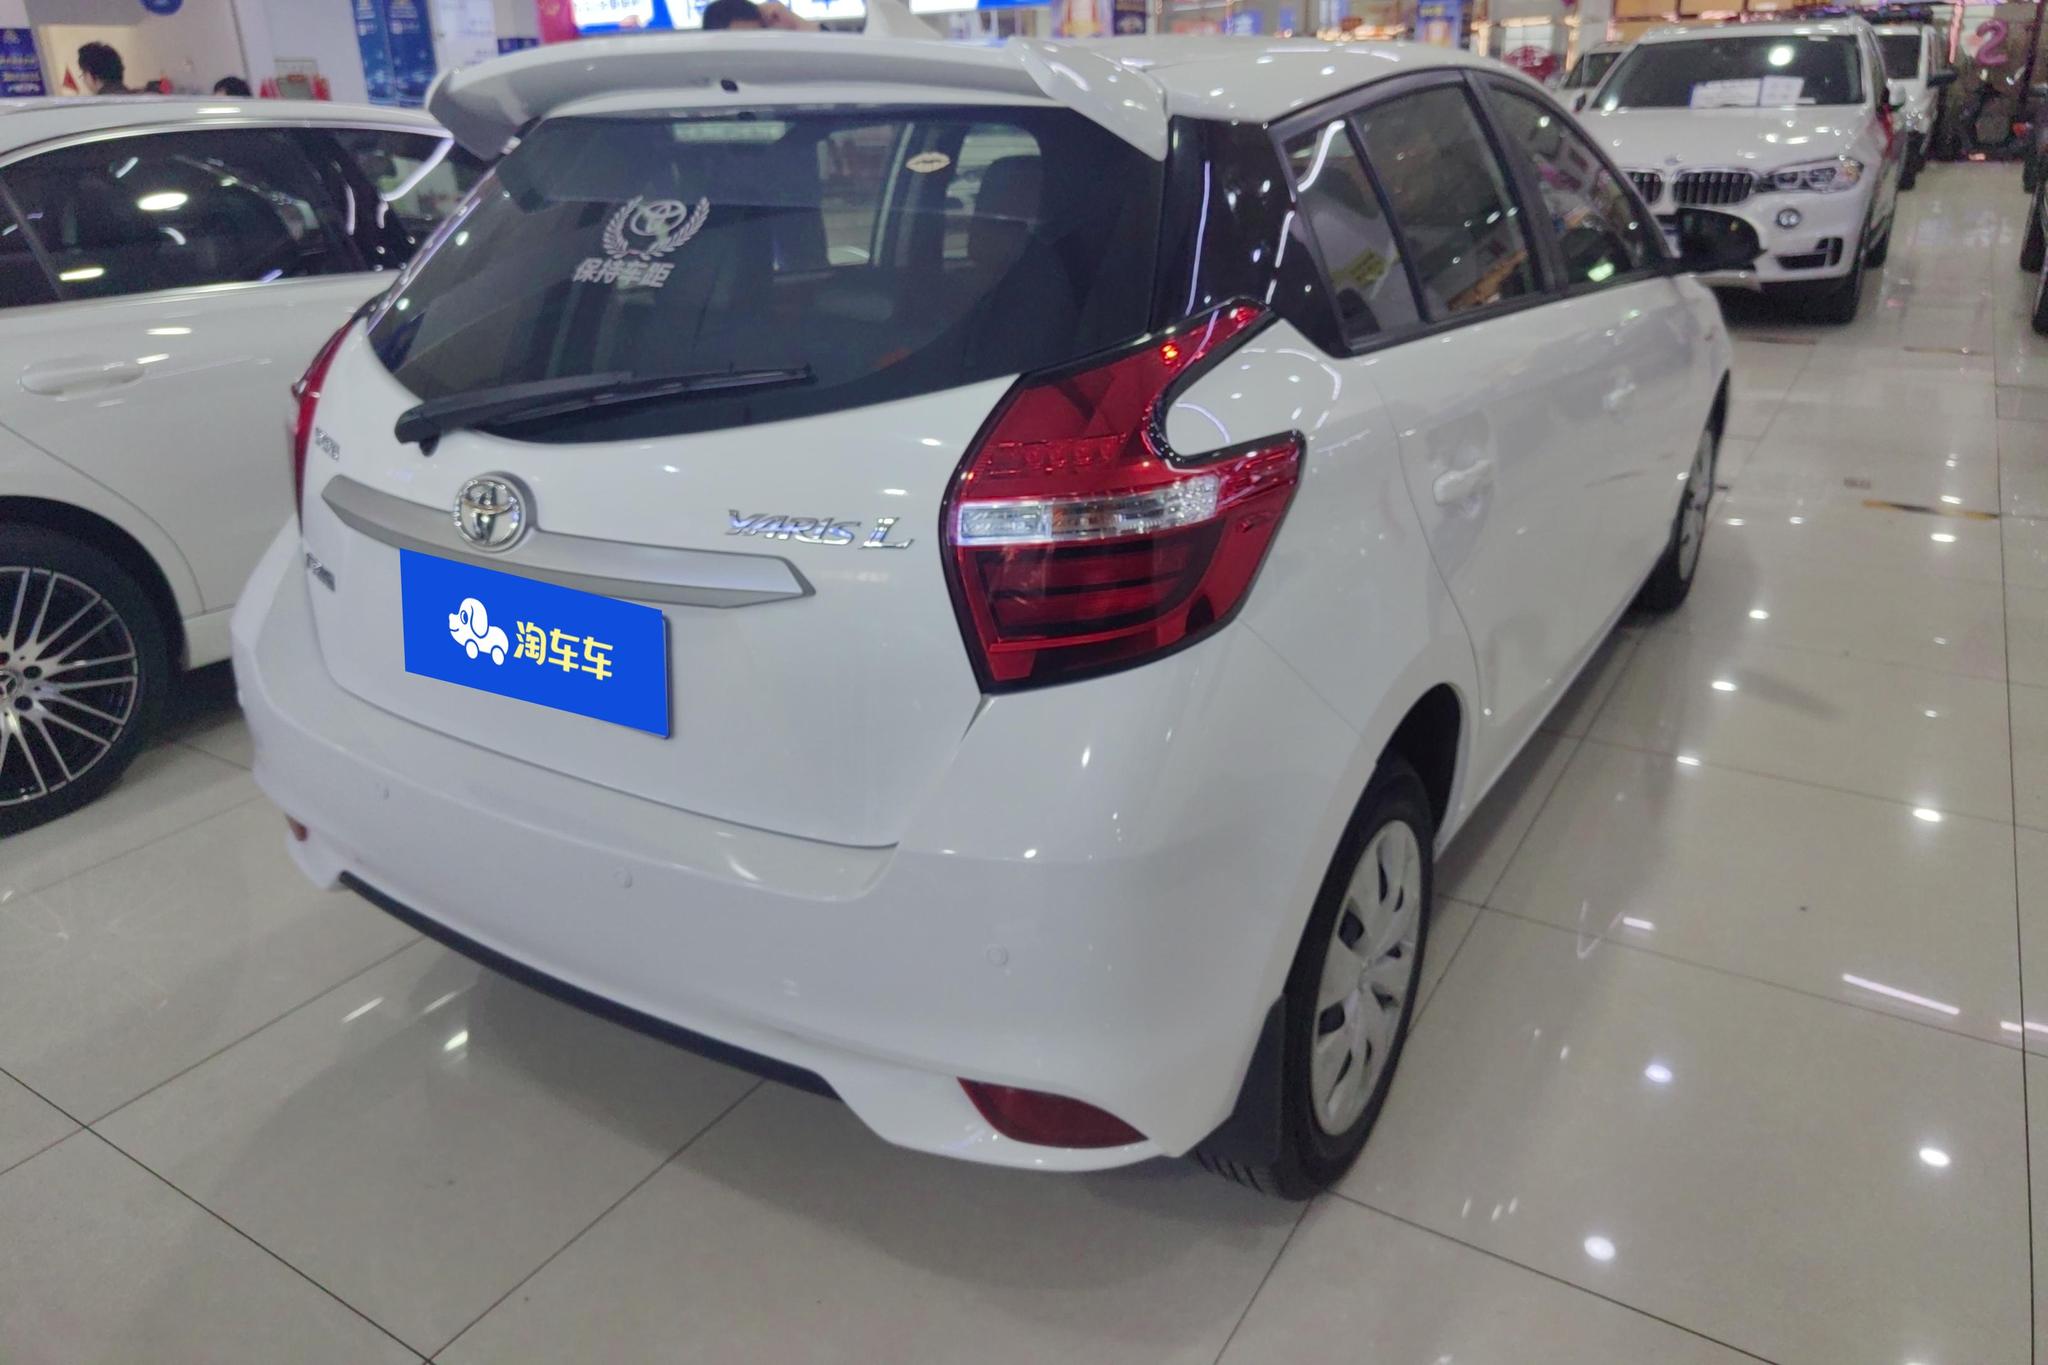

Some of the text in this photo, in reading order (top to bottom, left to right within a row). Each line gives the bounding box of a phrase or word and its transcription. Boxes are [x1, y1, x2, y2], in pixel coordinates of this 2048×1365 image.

[1976, 18, 2008, 66] 2
[573, 257, 675, 288] 保持车距
[725, 509, 915, 550] YARIS L
